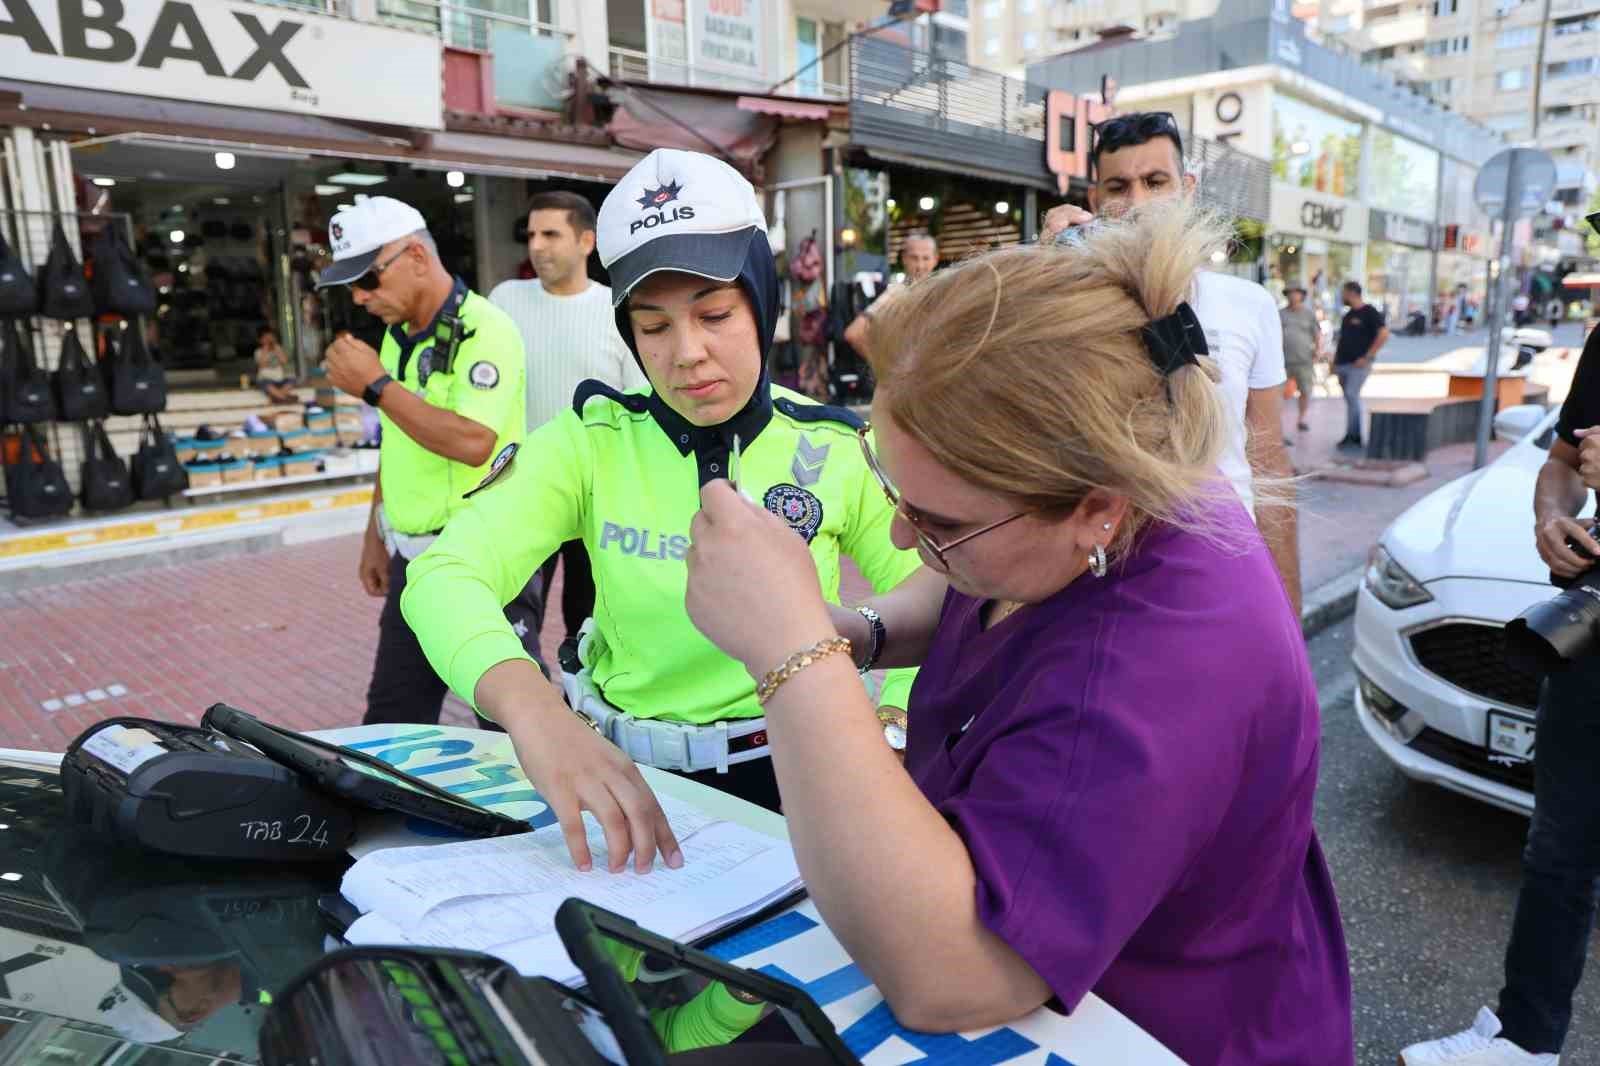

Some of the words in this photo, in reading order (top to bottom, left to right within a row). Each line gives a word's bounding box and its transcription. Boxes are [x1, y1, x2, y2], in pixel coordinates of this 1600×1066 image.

[630, 206, 695, 235] POLIS
[240, 820, 281, 841] TAB
[287, 814, 329, 849] 24
